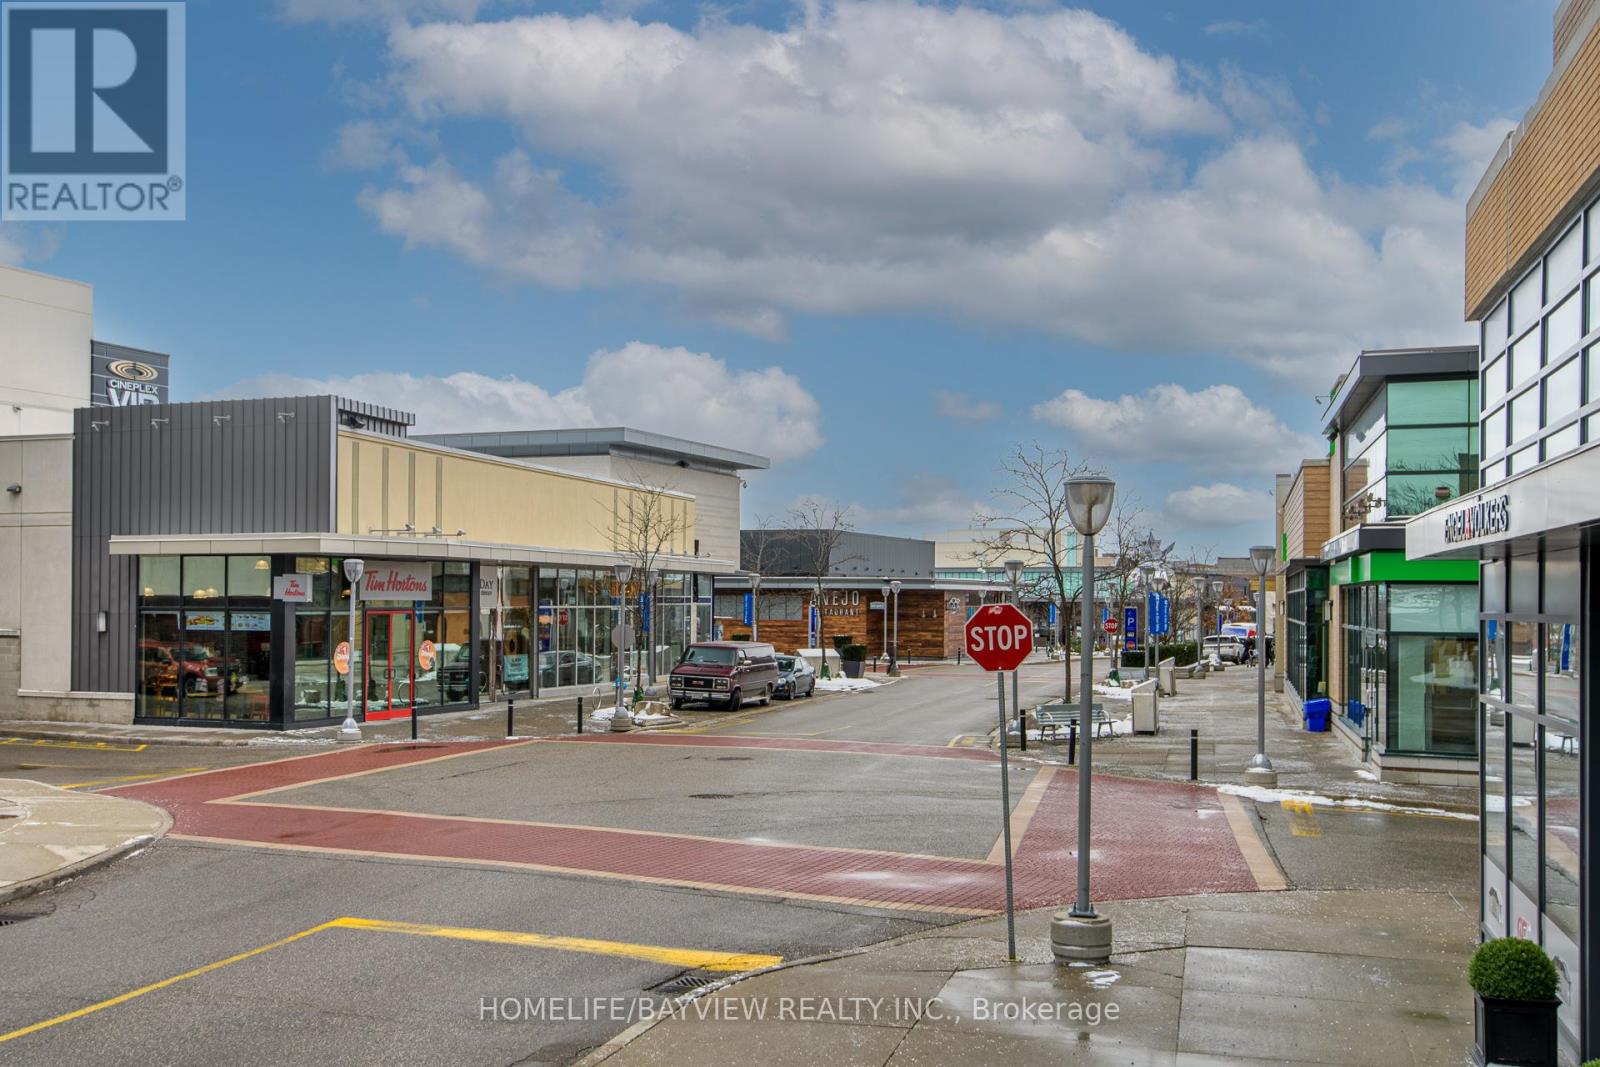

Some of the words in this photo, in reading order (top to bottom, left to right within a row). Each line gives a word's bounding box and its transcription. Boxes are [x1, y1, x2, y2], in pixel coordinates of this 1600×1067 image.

[110, 380, 158, 394] CINEPLEX
[365, 569, 384, 592] Tim
[387, 568, 427, 592] Hortons
[1104, 622, 1118, 630] STOP
[970, 625, 1027, 652] STOP
